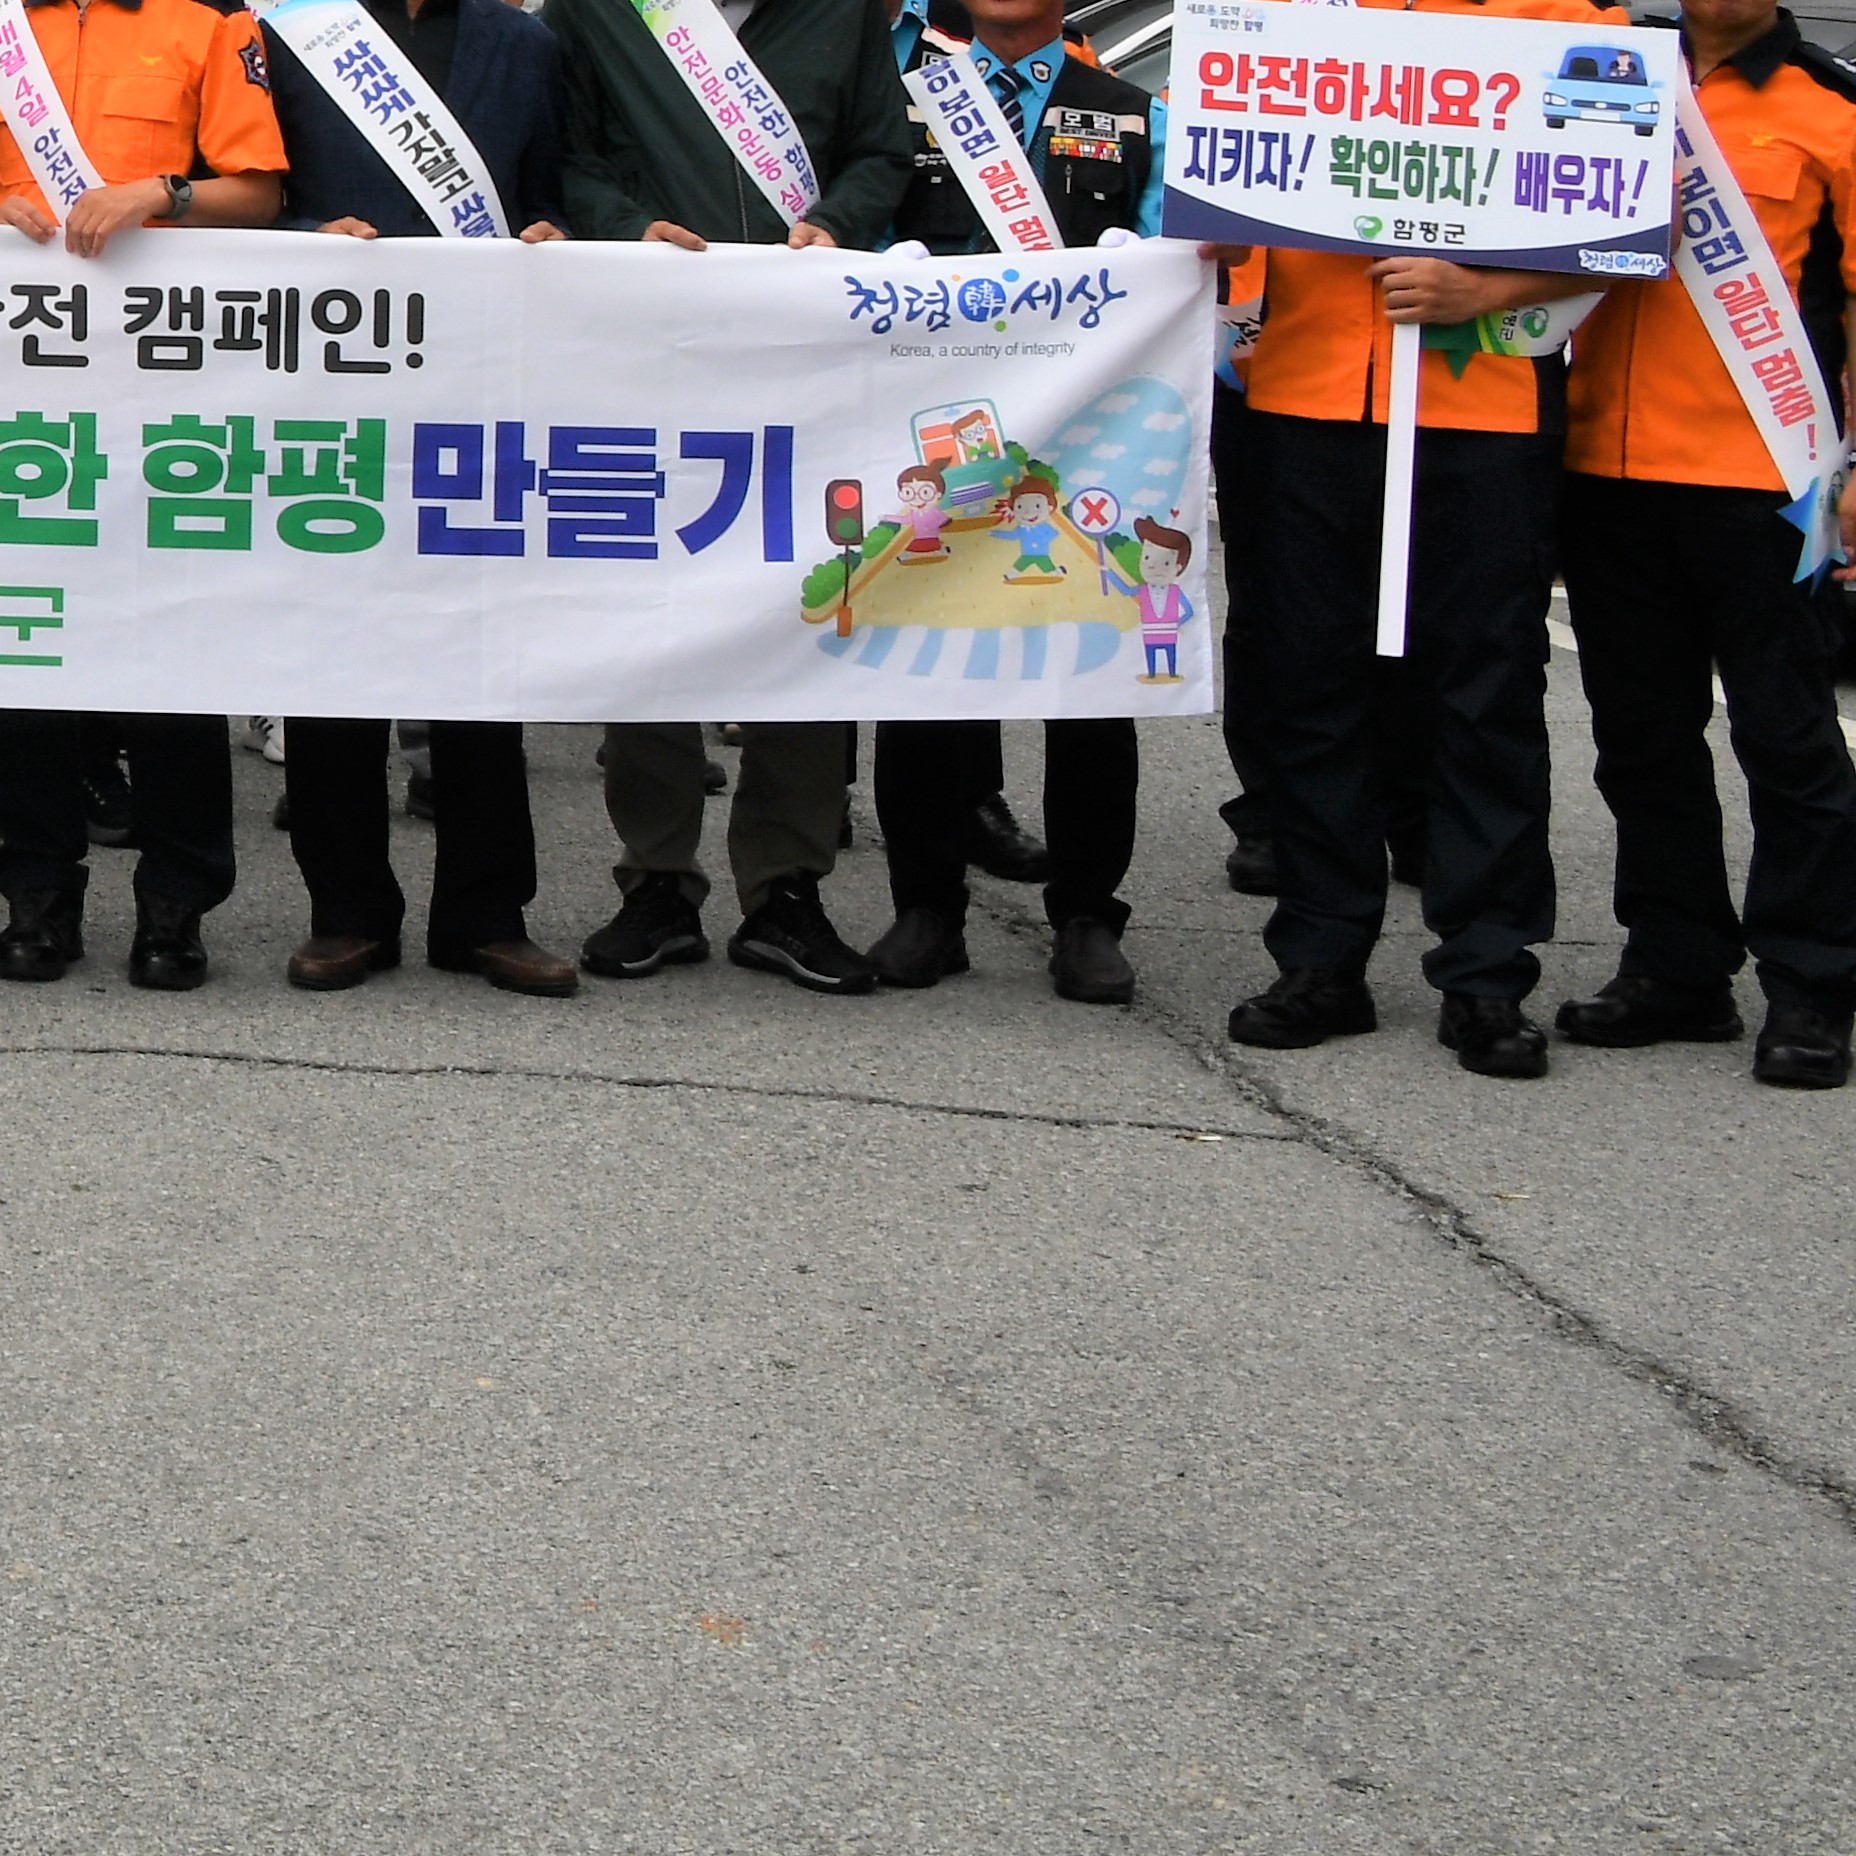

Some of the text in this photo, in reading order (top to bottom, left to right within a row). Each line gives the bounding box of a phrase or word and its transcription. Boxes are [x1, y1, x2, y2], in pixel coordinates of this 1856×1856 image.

[1186, 3, 1241, 17] 새로운 도약
[1208, 17, 1264, 33] 희망찬 함평
[15, 74, 49, 128] 4일
[332, 39, 475, 204] 싸게싸게 가지말고
[724, 60, 816, 196] 안전한 함평
[1064, 111, 1113, 132] 모범
[1198, 50, 1521, 132] 안전하세요?
[938, 89, 1001, 160] 보이면
[978, 159, 1031, 214] 일단
[1183, 125, 1650, 219] 지키자! 확인하자! 배우자!
[1392, 218, 1465, 245] 함평군
[1678, 164, 1751, 276] 보이면
[123, 286, 425, 374] 캠페인!
[890, 341, 1076, 360] Korea, a country of integrity
[1713, 272, 1785, 352] 일단
[142, 412, 387, 555] 함평
[412, 421, 796, 563] 만들기
